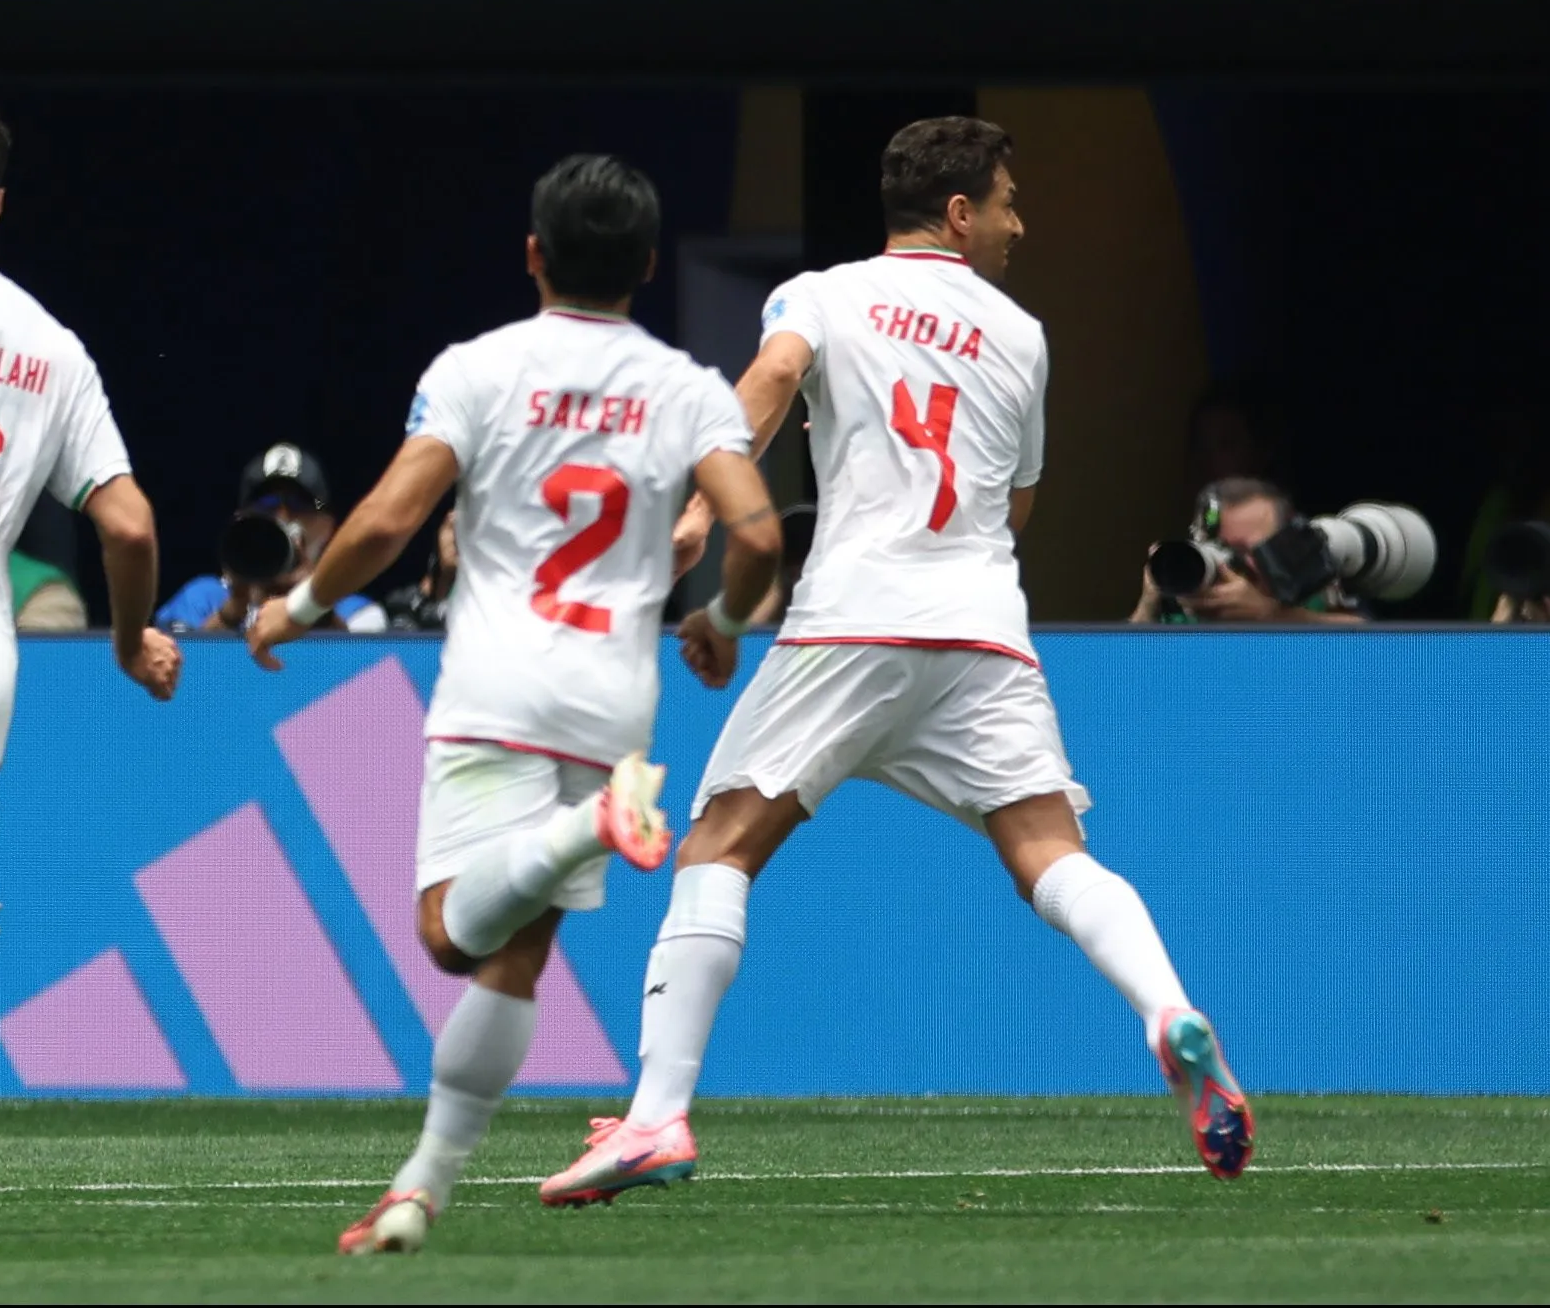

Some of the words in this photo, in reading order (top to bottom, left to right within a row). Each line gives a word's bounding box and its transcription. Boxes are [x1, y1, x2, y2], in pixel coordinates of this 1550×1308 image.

[867, 303, 984, 361] SHOJA
[527, 389, 648, 436] SALEH
[889, 378, 961, 533] 4
[529, 463, 632, 635] 2
